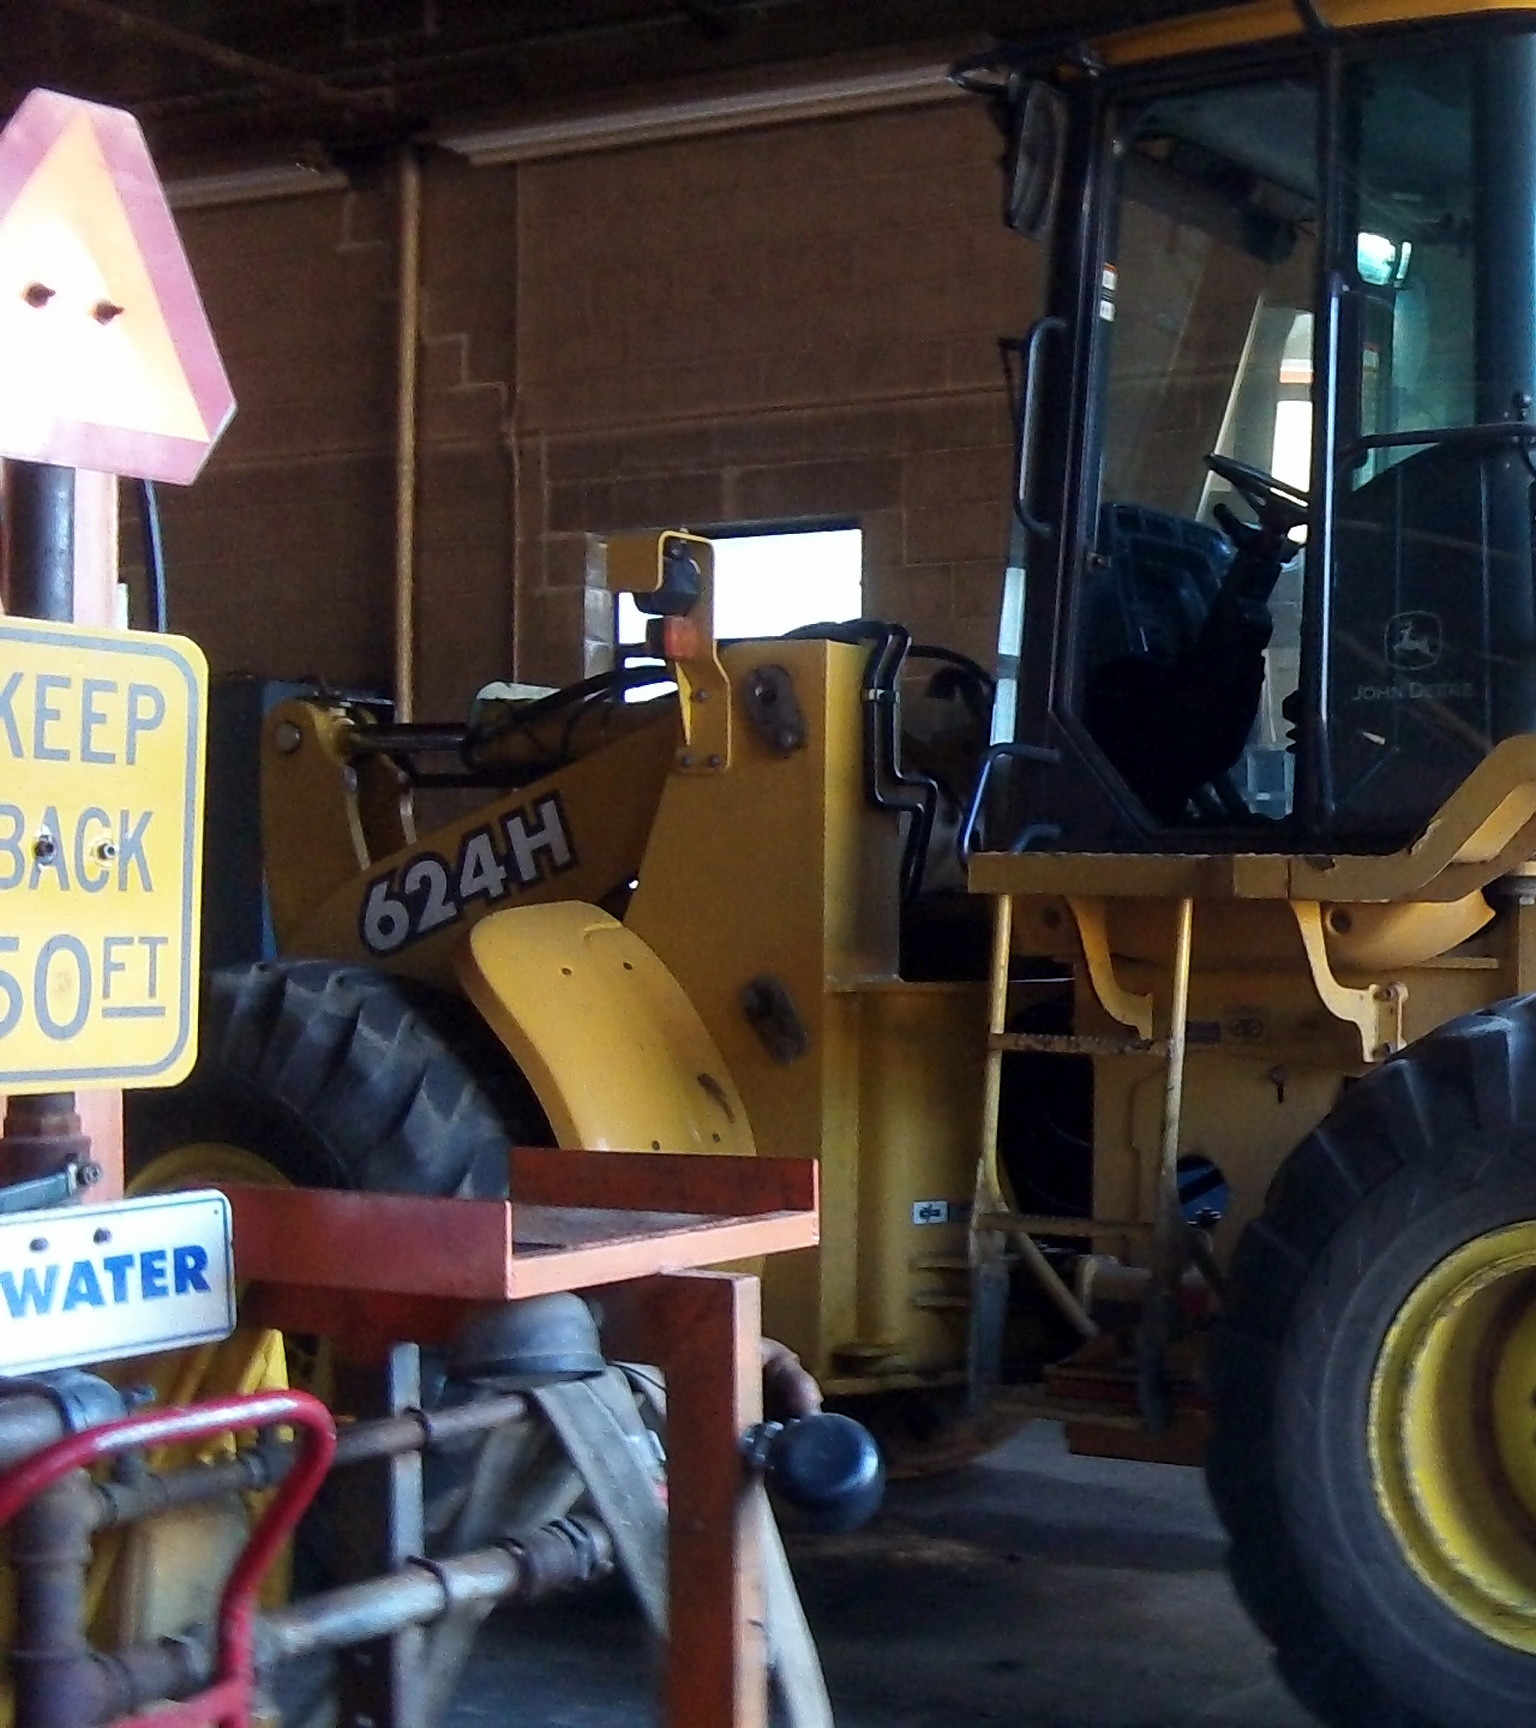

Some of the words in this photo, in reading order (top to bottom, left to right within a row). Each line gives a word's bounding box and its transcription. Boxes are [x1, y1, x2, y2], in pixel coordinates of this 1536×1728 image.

[0, 671, 166, 766] KEEP
[0, 805, 154, 892] BACK
[364, 799, 572, 951] 624H
[0, 1244, 211, 1319] WATER
